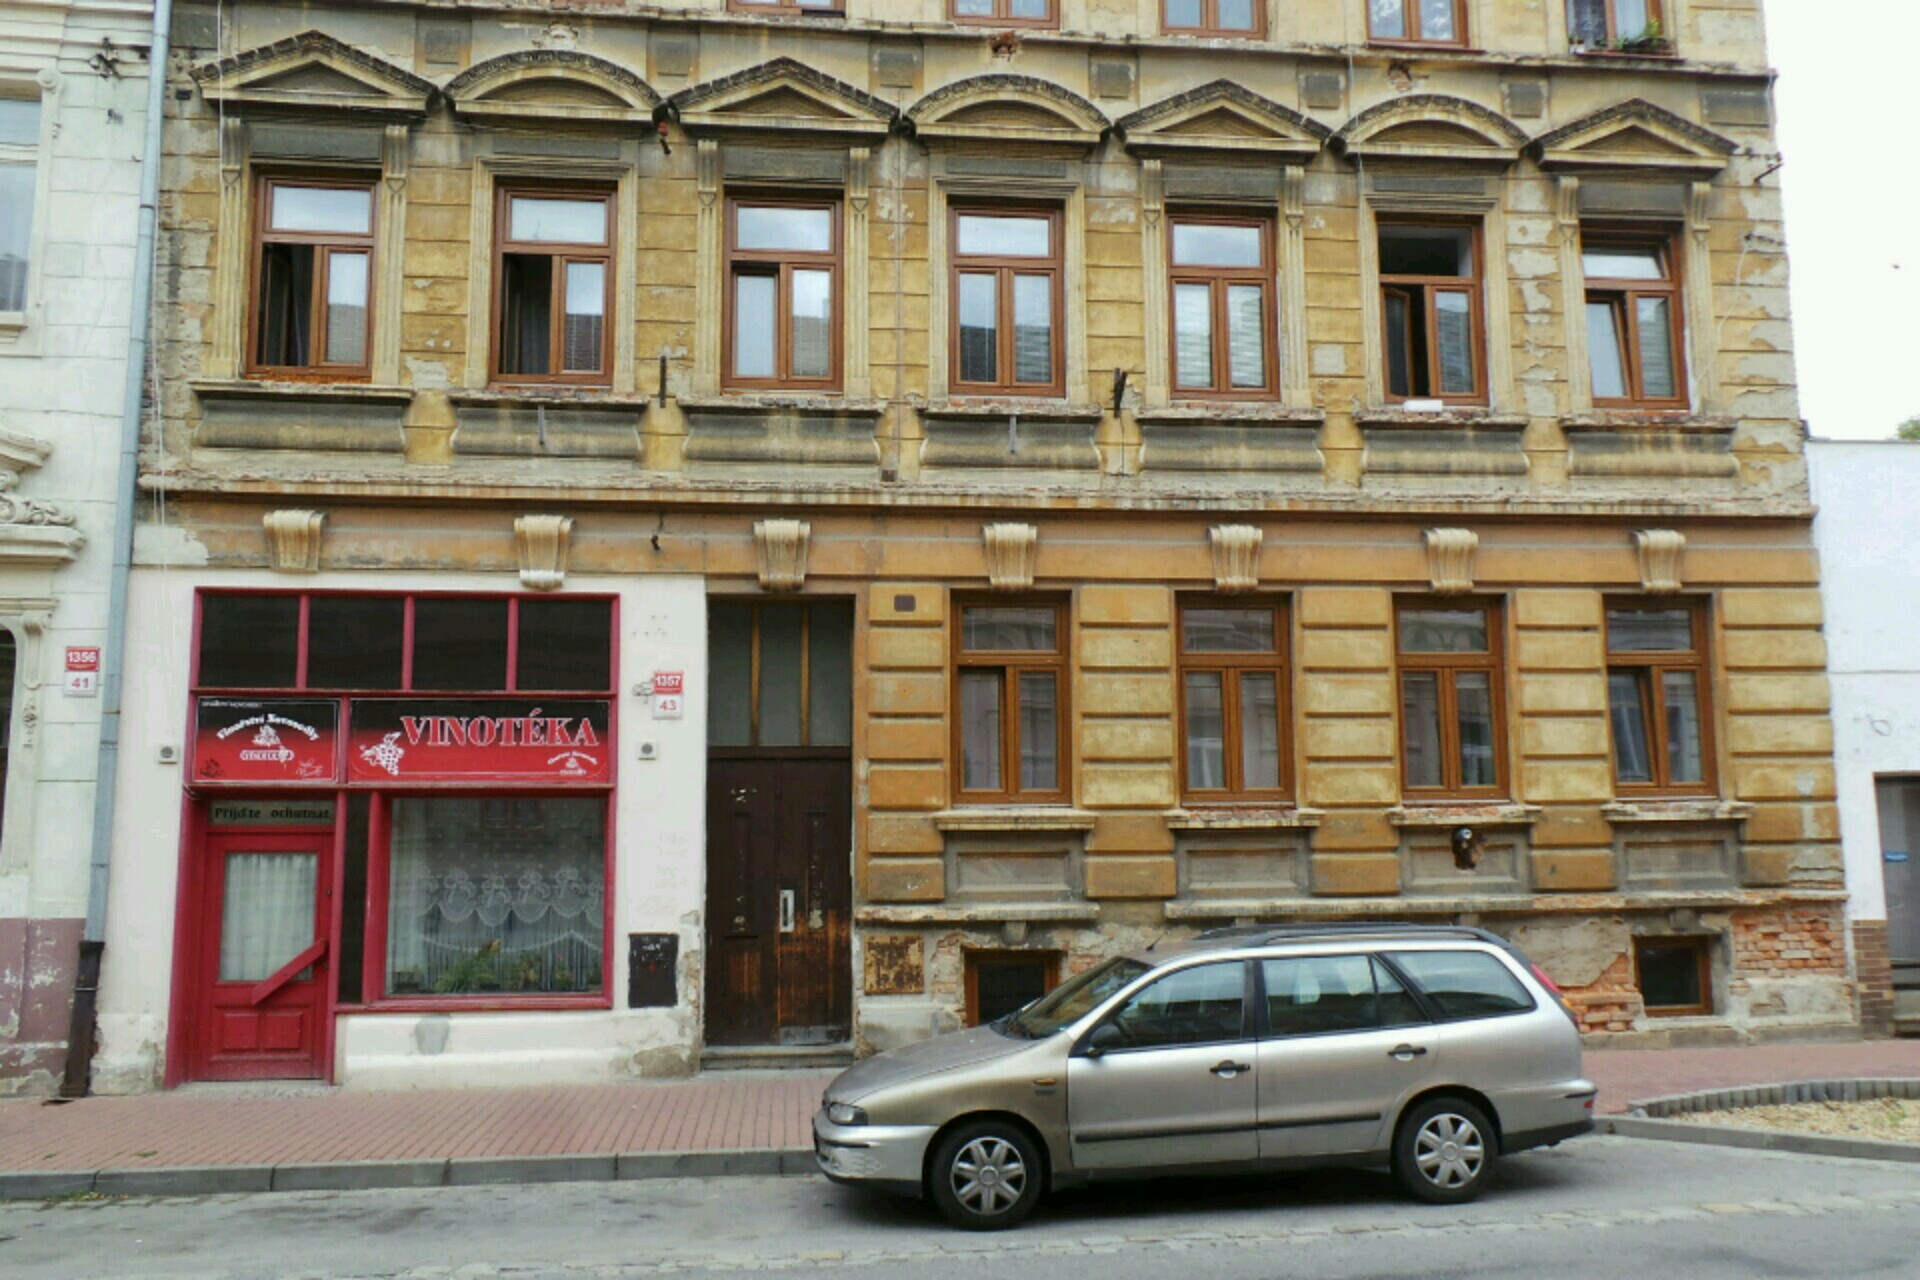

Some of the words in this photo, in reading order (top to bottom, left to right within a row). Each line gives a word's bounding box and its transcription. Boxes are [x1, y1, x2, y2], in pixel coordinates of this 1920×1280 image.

[72, 677, 89, 689] 41
[655, 675, 681, 687] 1357
[659, 699, 677, 712] 43
[400, 707, 600, 747] VINOTÉKA
